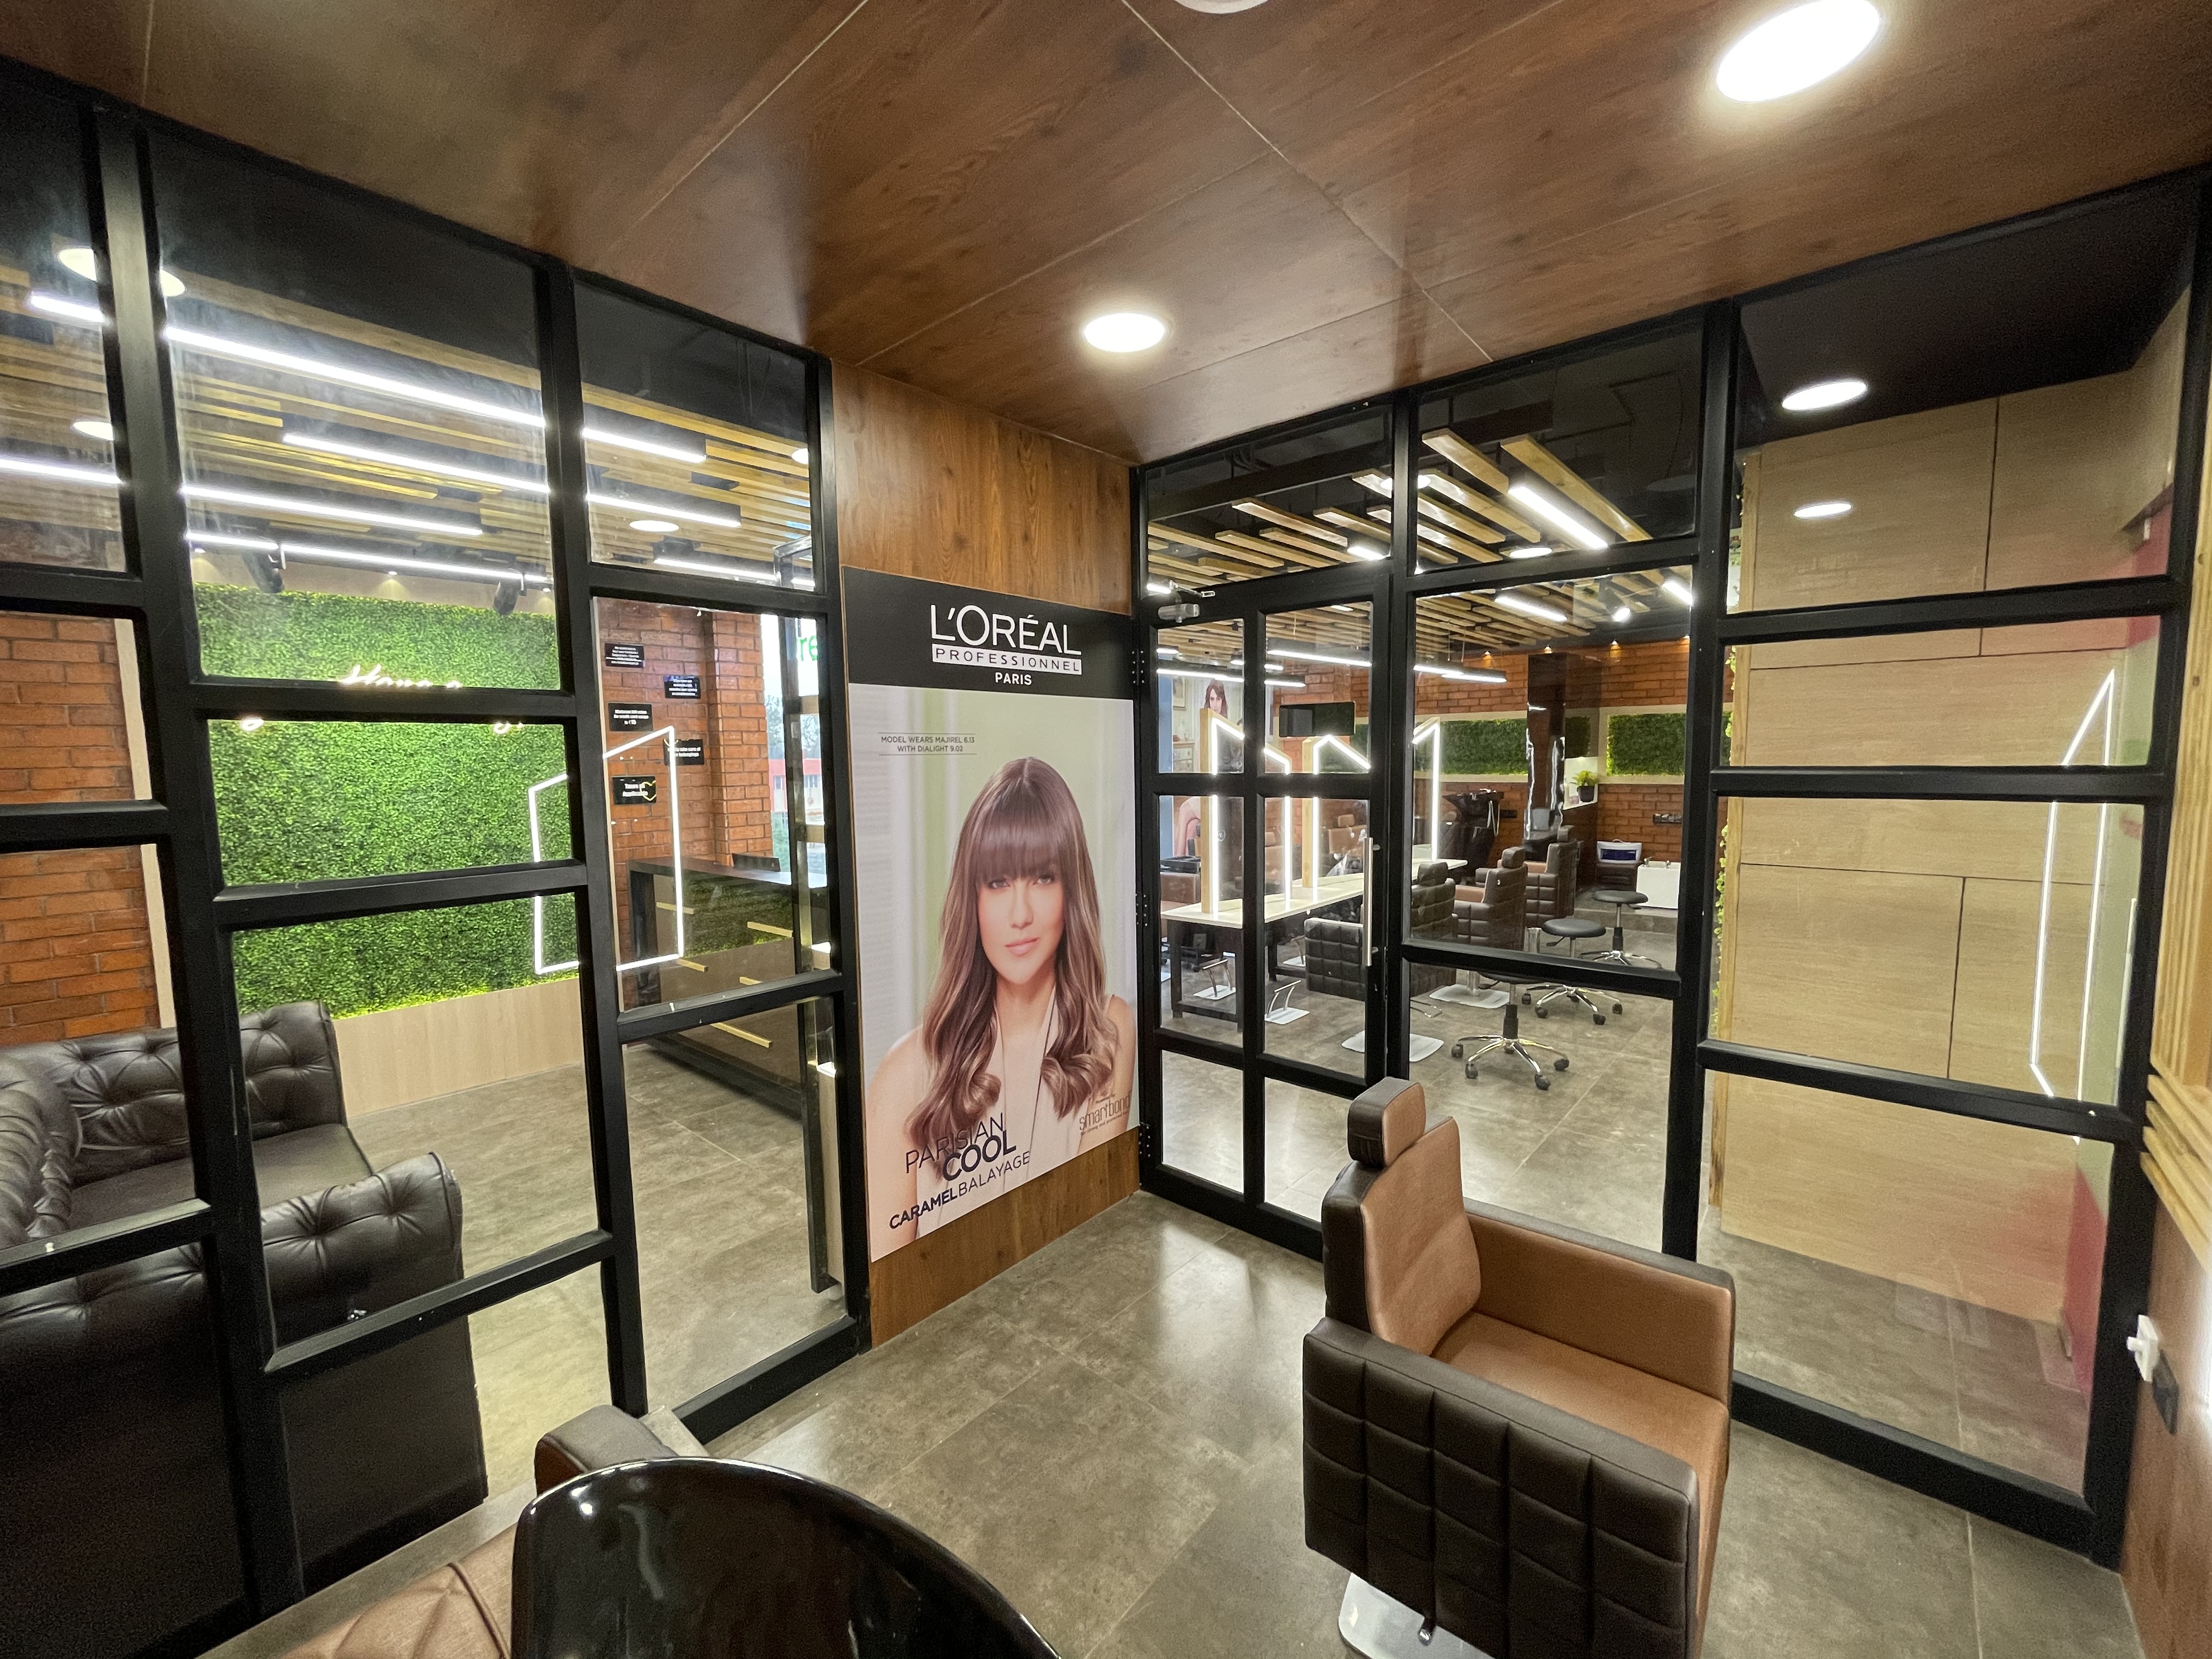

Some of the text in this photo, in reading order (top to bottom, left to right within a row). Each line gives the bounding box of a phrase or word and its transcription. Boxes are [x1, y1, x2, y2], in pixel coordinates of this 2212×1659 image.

[930, 604, 1082, 656] L'ORÉAL
[935, 647, 1080, 672] PROFESSIONNEL
[995, 672, 1032, 686] PARIS
[1079, 1090, 1131, 1131] smartbond
[906, 1112, 1003, 1174] PARISIAN
[942, 1130, 1017, 1181] COOL
